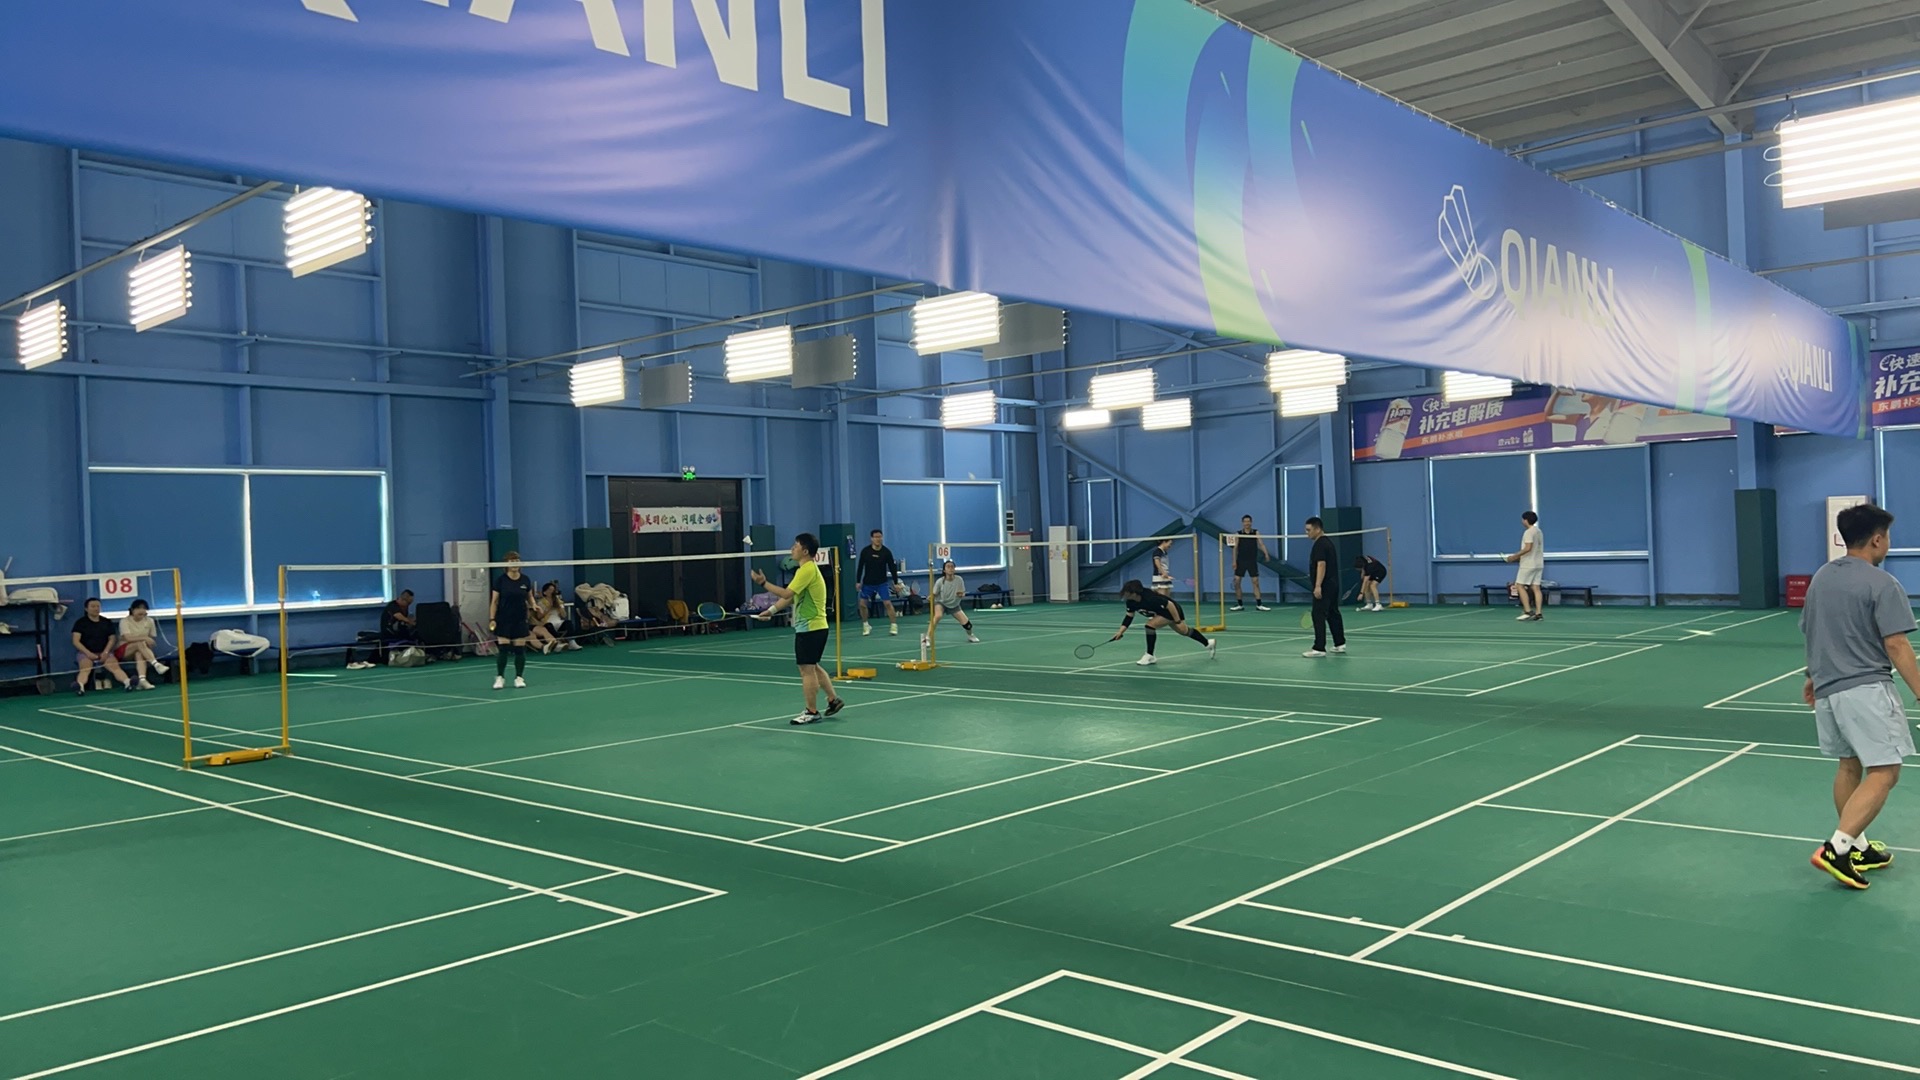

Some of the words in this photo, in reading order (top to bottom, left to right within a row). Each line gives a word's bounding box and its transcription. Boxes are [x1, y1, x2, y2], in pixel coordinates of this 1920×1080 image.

[1501, 228, 1615, 329] QIANLI
[1790, 336, 1832, 392] QIANLI
[1419, 399, 1504, 434] 补充电解质
[814, 551, 826, 562] 07
[938, 547, 949, 556] 06
[105, 578, 132, 594] 08
